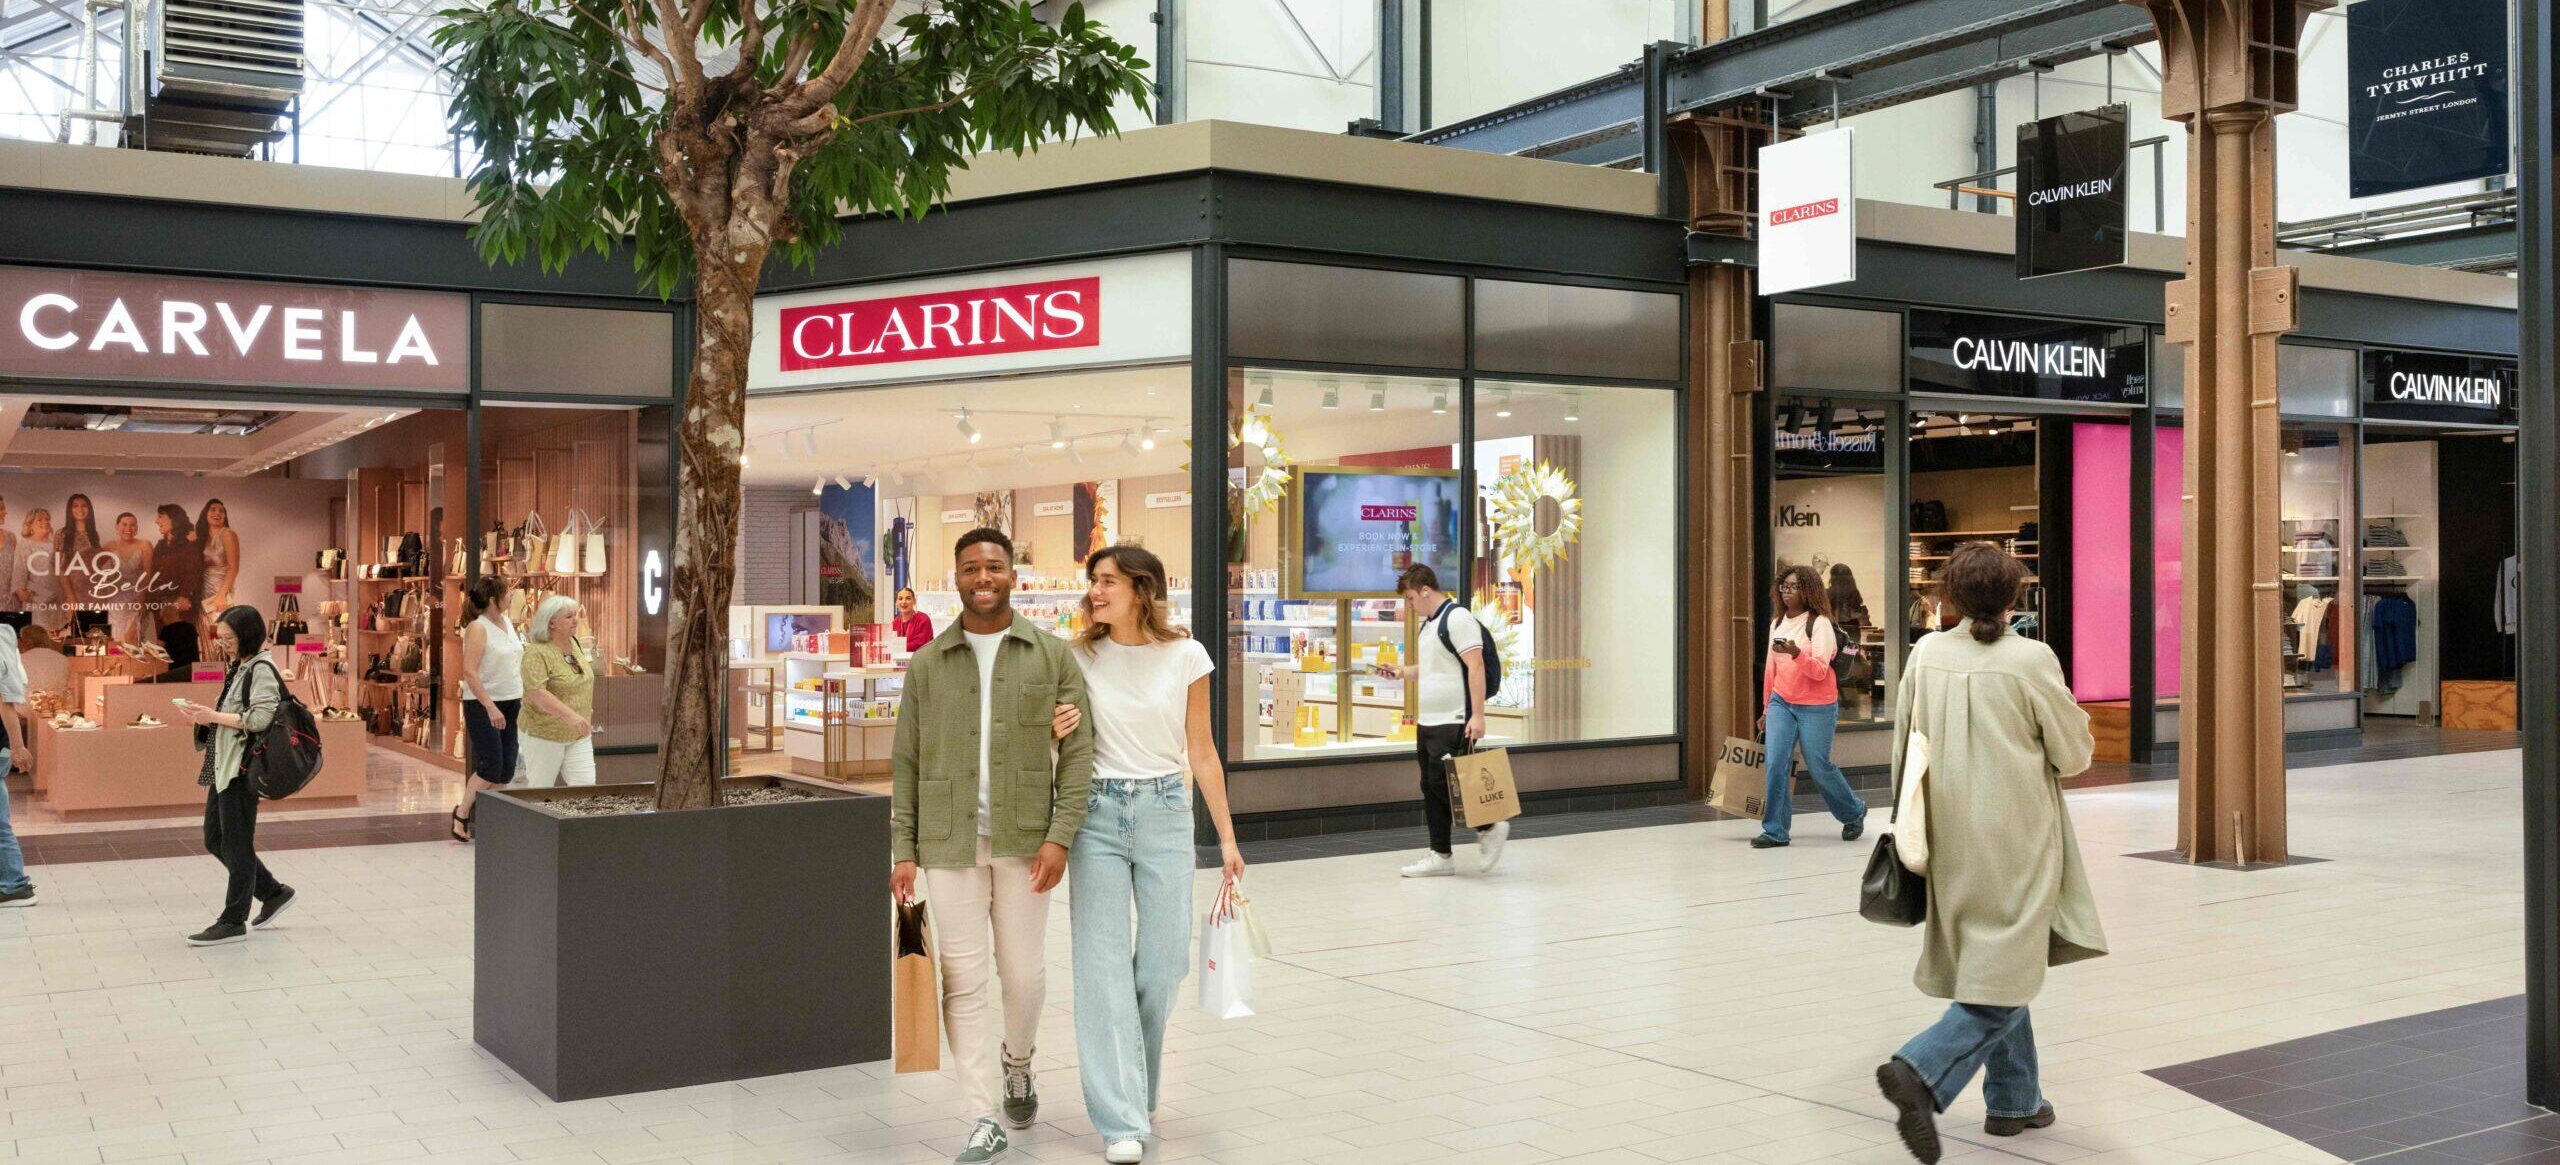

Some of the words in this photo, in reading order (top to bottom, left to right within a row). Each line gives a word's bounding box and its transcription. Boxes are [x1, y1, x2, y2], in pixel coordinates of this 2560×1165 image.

[2382, 52, 2469, 78] CHARLES
[2366, 63, 2488, 98] TYRWHITT
[2376, 110, 2407, 122] JERMYN
[2409, 104, 2440, 115] STREET
[2442, 97, 2478, 109] LONDON
[2028, 184, 2073, 206] CALVIN
[2076, 178, 2112, 197] KLEIN
[1772, 200, 1836, 223] CLARINS
[19, 293, 440, 366] CARVELA
[791, 290, 1086, 360] CLARINS
[1953, 337, 2039, 374] CALVIN
[2044, 343, 2106, 378] KLEIN
[2390, 371, 2453, 402] CALVIN
[2455, 376, 2500, 405] KLEIN
[1361, 507, 1416, 518] CLARINS
[1780, 504, 1820, 527] Klein
[1338, 544, 1394, 552] EXPERIENCE
[1396, 544, 1437, 552] IN-STORE
[1359, 532, 1385, 540] BOOK
[1388, 532, 1409, 540] NOW
[26, 551, 121, 577] CIAO
[88, 568, 180, 599] Bella
[644, 550, 662, 615] C
[25, 602, 57, 612] FROM
[61, 602, 85, 611] OUR
[88, 602, 125, 611] FAMILY
[127, 602, 142, 611] TO
[1479, 790, 1504, 804] LUKE
